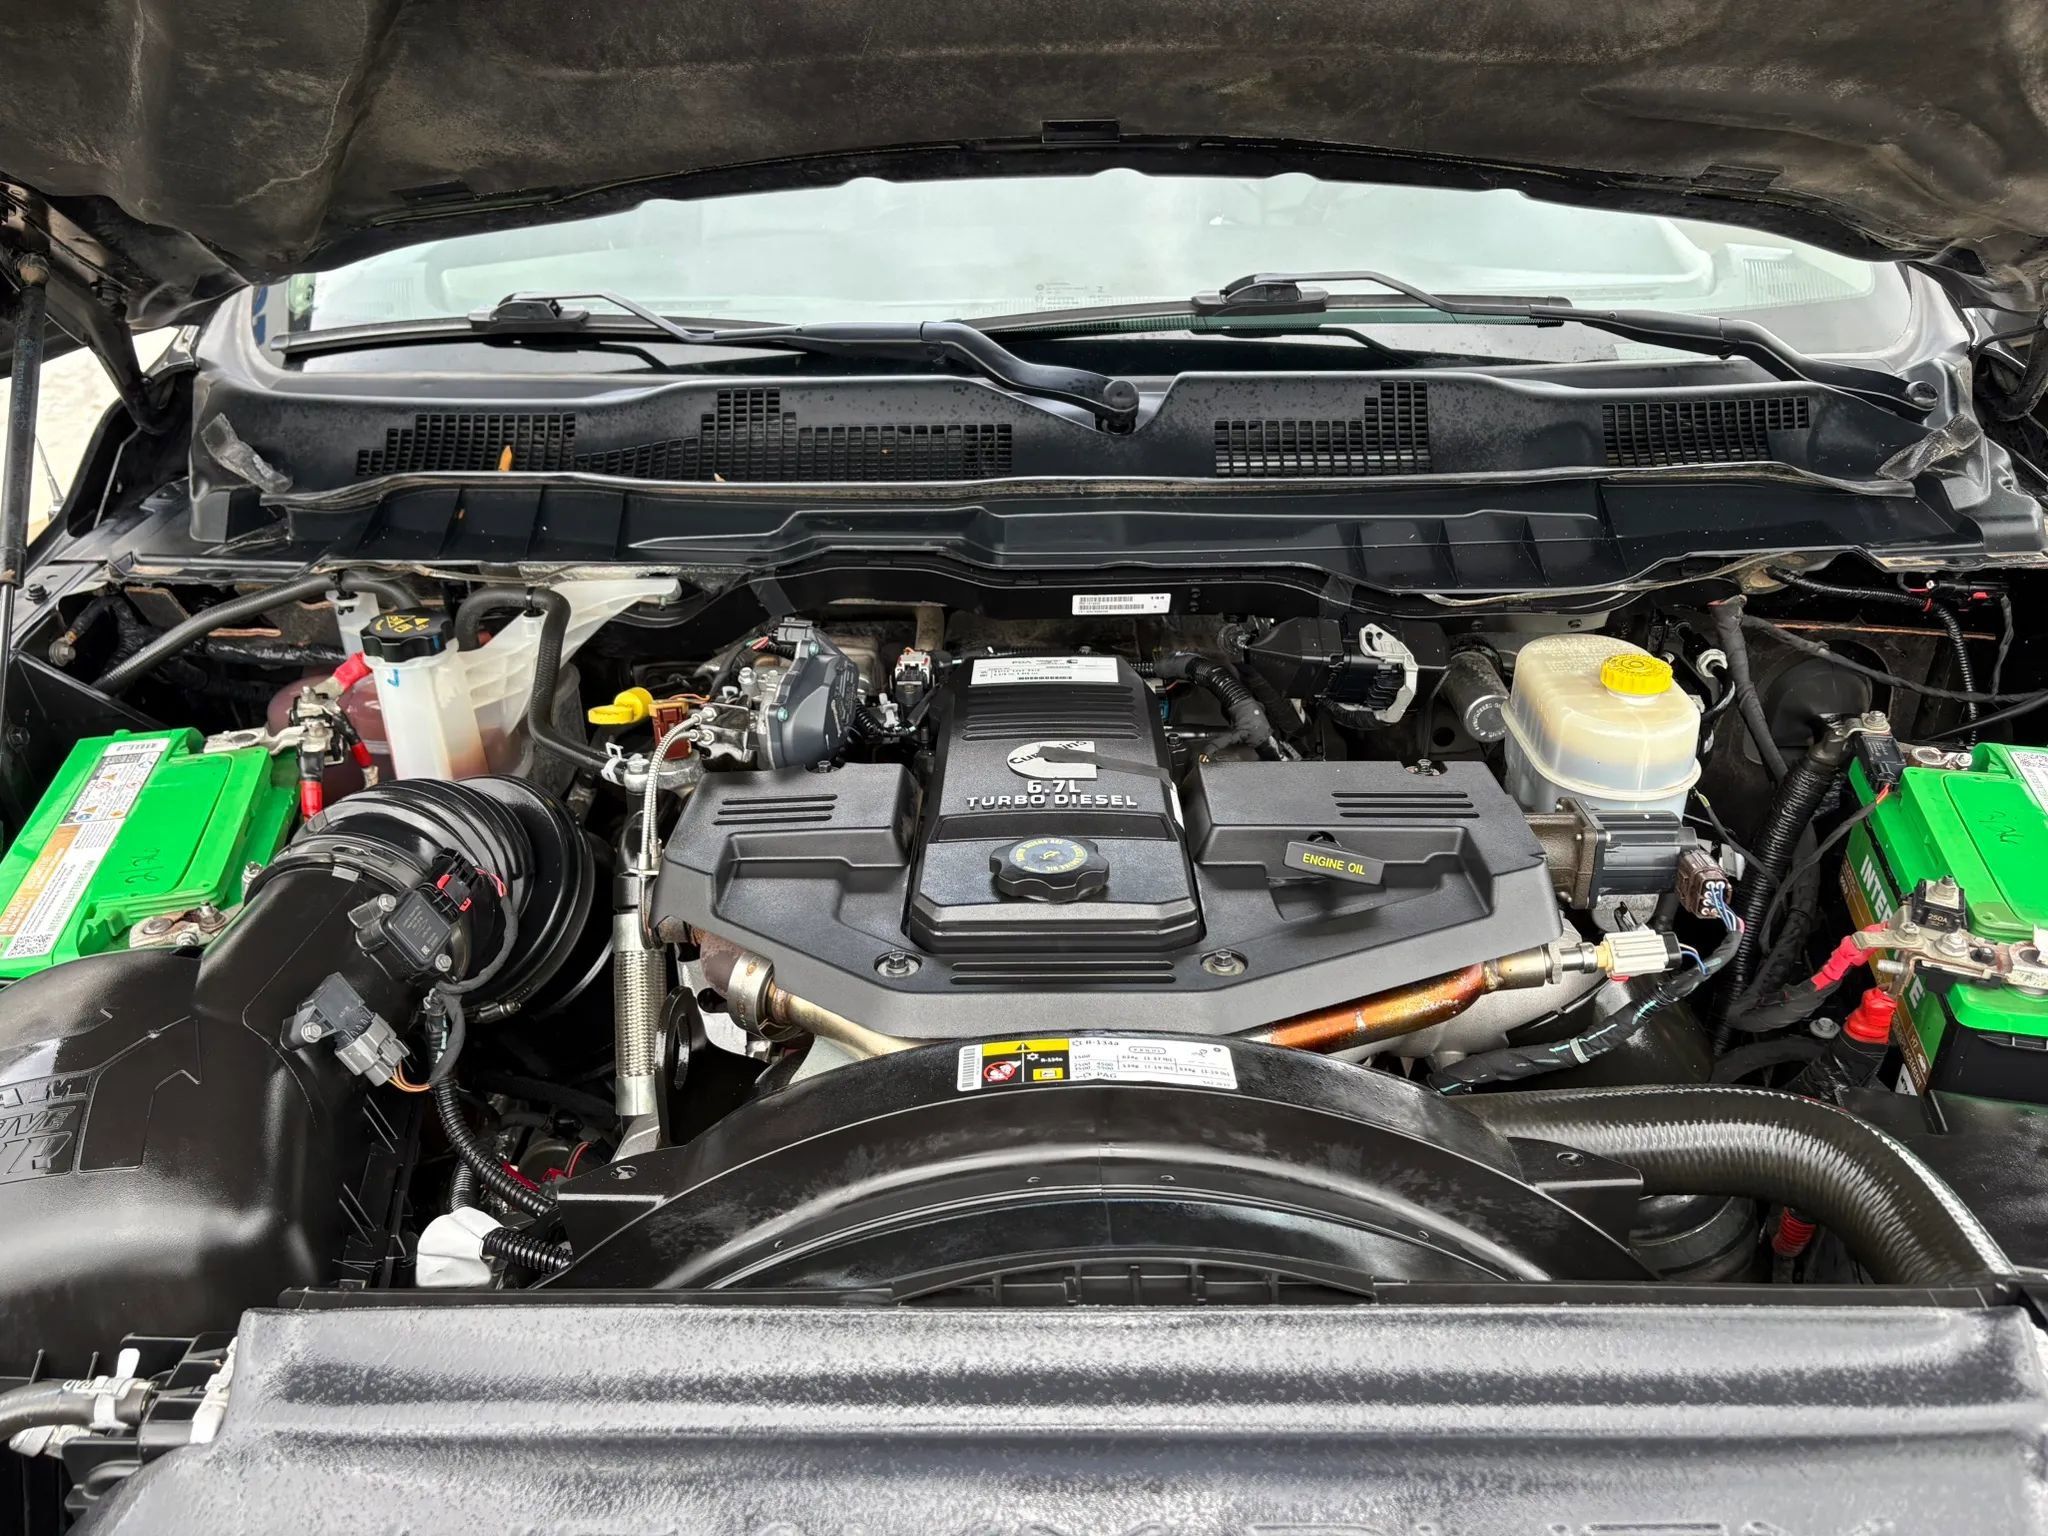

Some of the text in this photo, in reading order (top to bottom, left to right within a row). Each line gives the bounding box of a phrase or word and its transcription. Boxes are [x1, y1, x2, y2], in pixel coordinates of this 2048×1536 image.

[1009, 741, 1087, 764] Cuins
[1027, 780, 1082, 795] 6.7L
[967, 794, 1138, 809] TURBO DIESEL
[1302, 853, 1366, 875] ENGINE OIL
